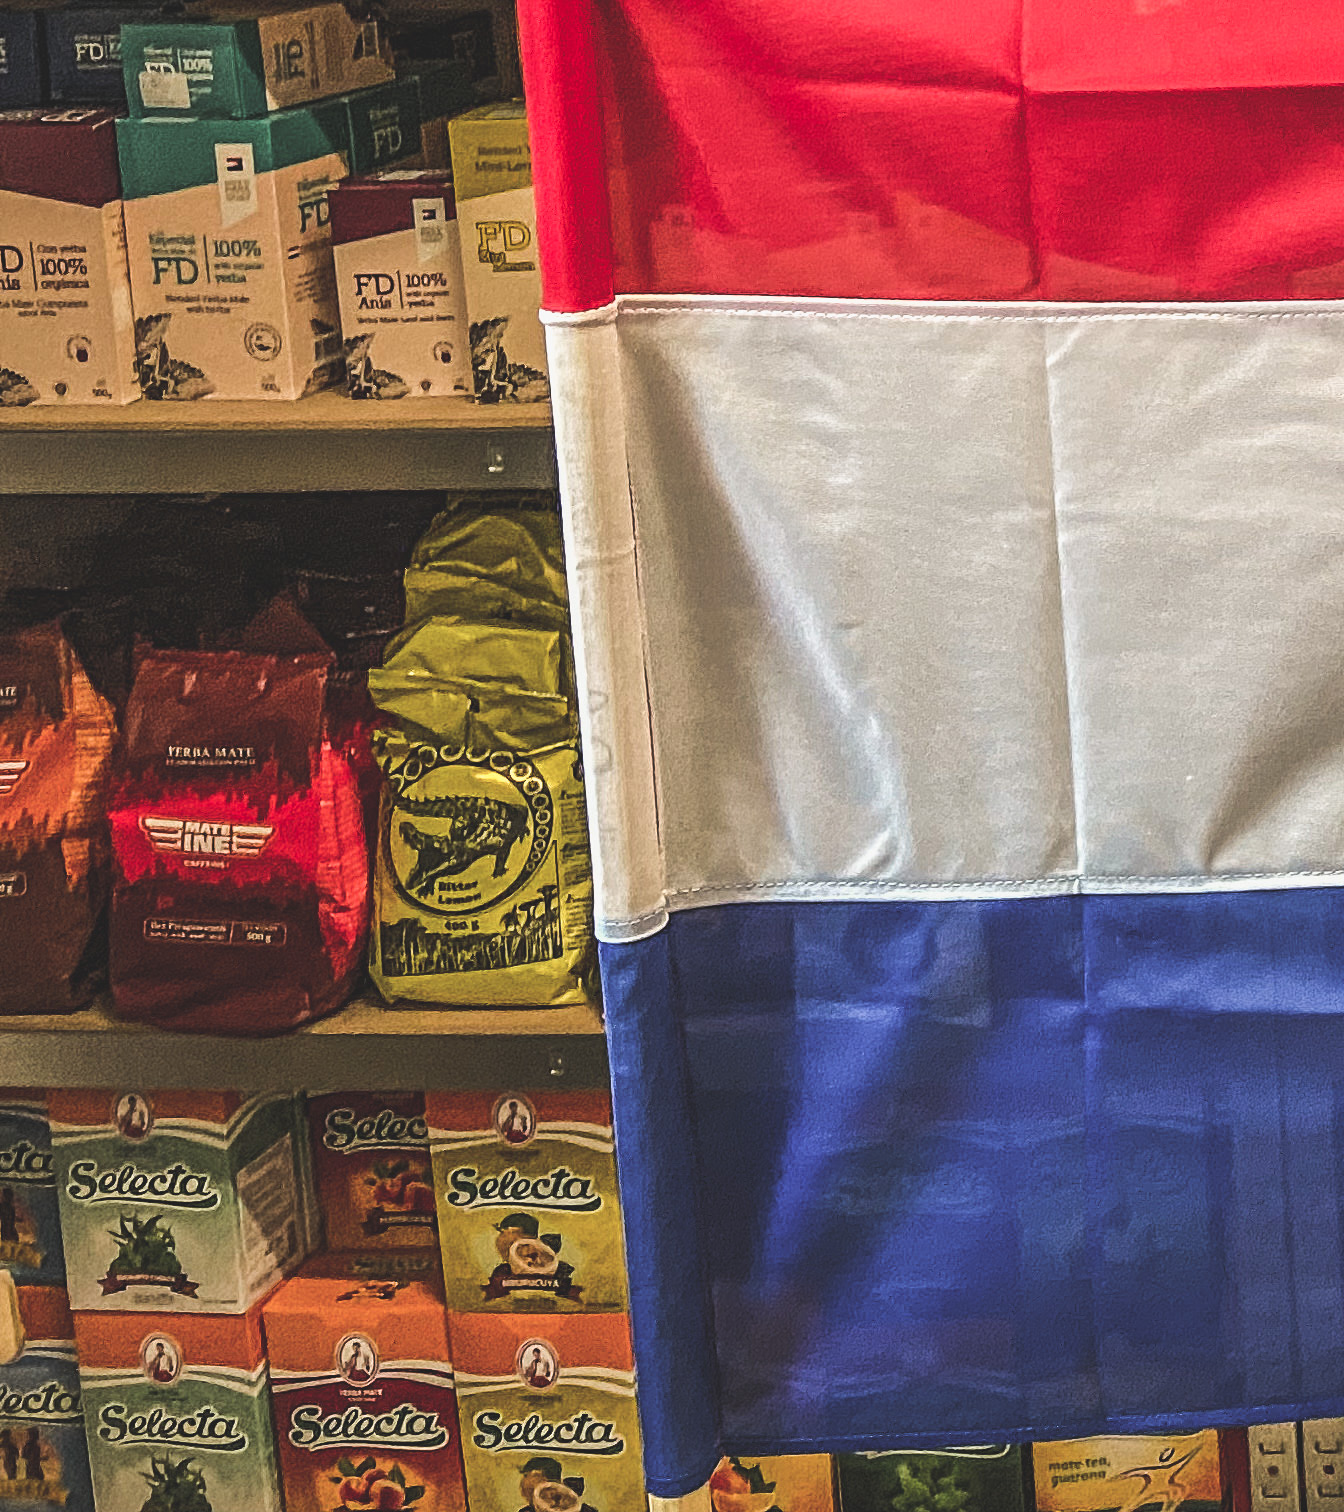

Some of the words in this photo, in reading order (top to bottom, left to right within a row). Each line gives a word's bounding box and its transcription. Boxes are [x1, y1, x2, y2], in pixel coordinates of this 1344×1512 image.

[75, 41, 104, 61] FD
[300, 202, 331, 234] FD
[476, 221, 532, 253] FD
[39, 258, 88, 276] 100%
[152, 257, 199, 285] FD
[214, 239, 262, 257] 100%
[355, 274, 394, 296] FD
[406, 273, 447, 288] 100%
[359, 296, 392, 309] Anís
[167, 746, 210, 760] YERBA
[215, 746, 254, 758] MATE
[183, 835, 231, 855] INE
[67, 1161, 214, 1203] Selecta
[447, 1167, 593, 1207] Selecta
[100, 1405, 240, 1442] Selecta
[291, 1405, 441, 1444] Selecta
[473, 1410, 617, 1451] Selecta
